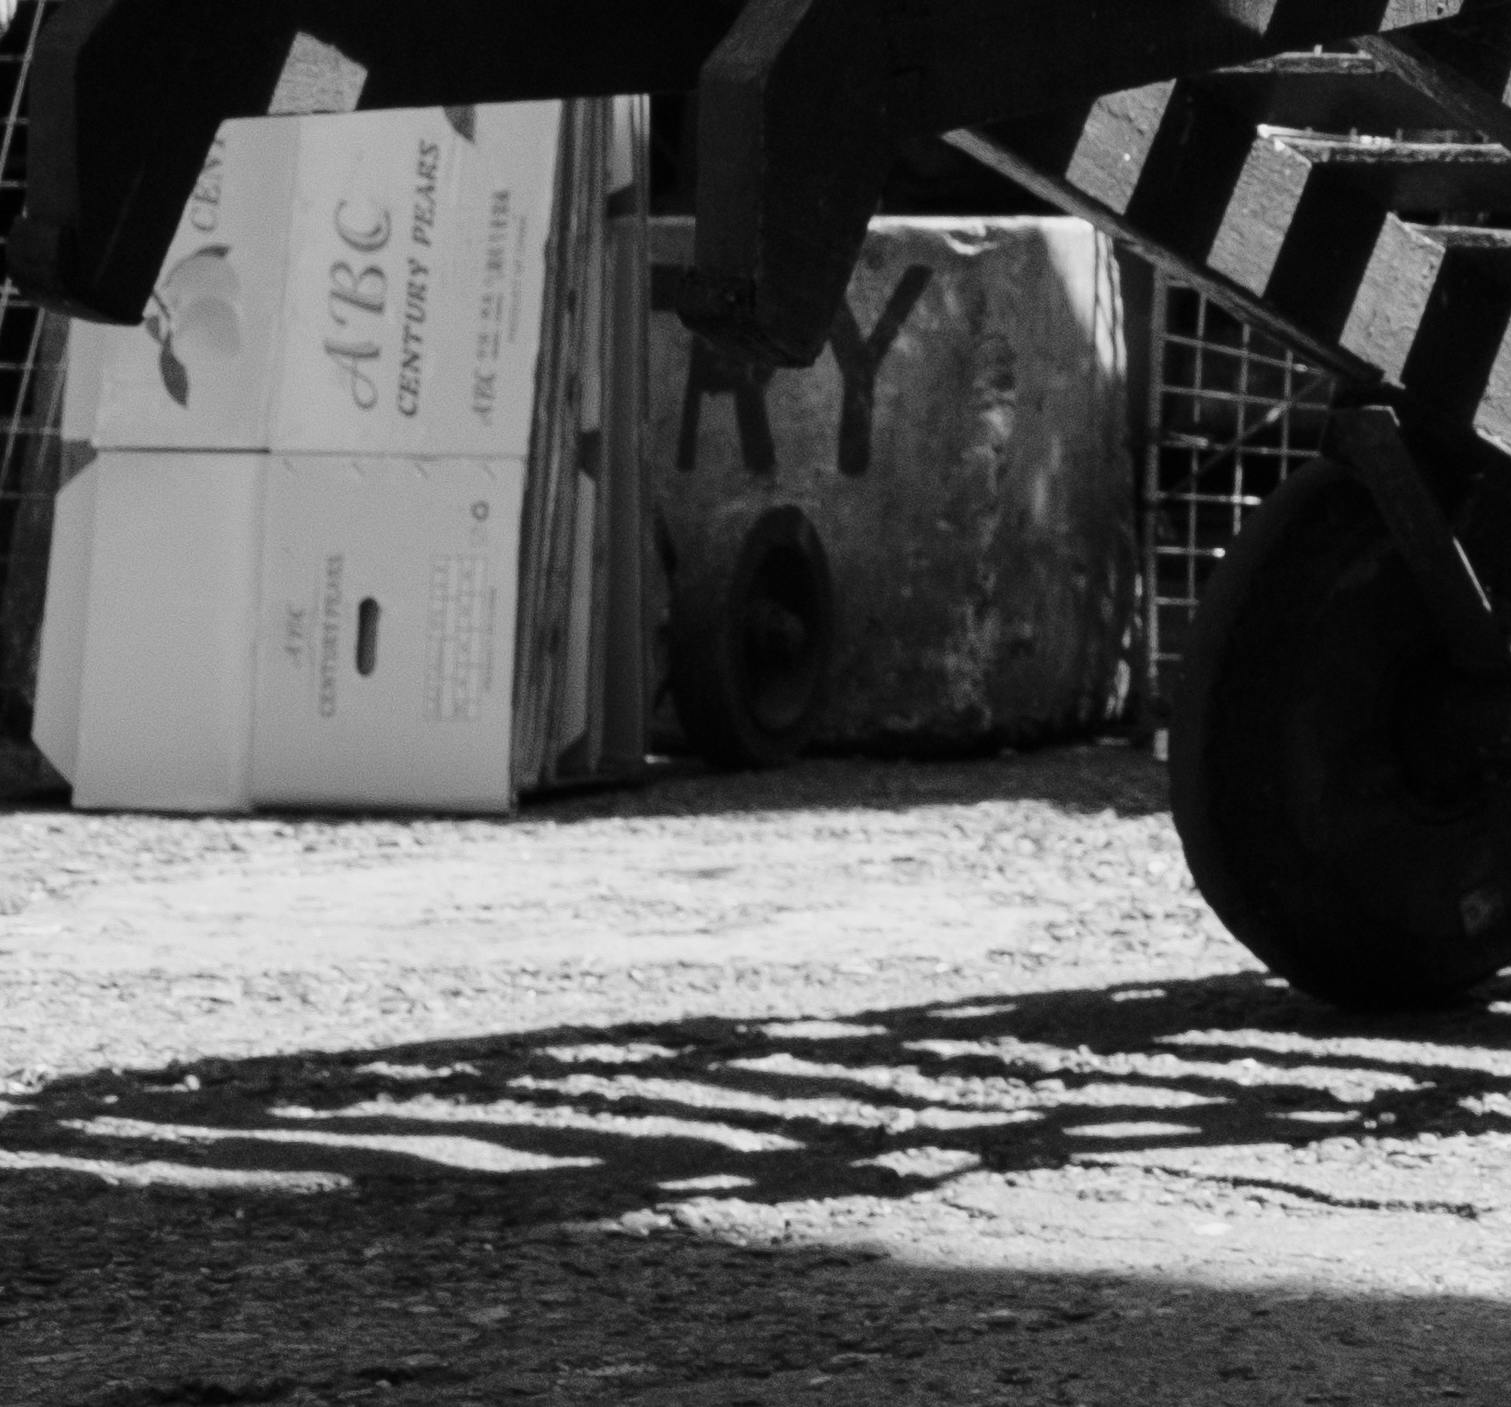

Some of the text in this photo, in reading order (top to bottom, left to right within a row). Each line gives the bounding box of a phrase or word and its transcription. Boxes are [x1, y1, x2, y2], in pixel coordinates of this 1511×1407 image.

[319, 198, 392, 411] ABC
[393, 139, 441, 418] CENTURY PEARS
